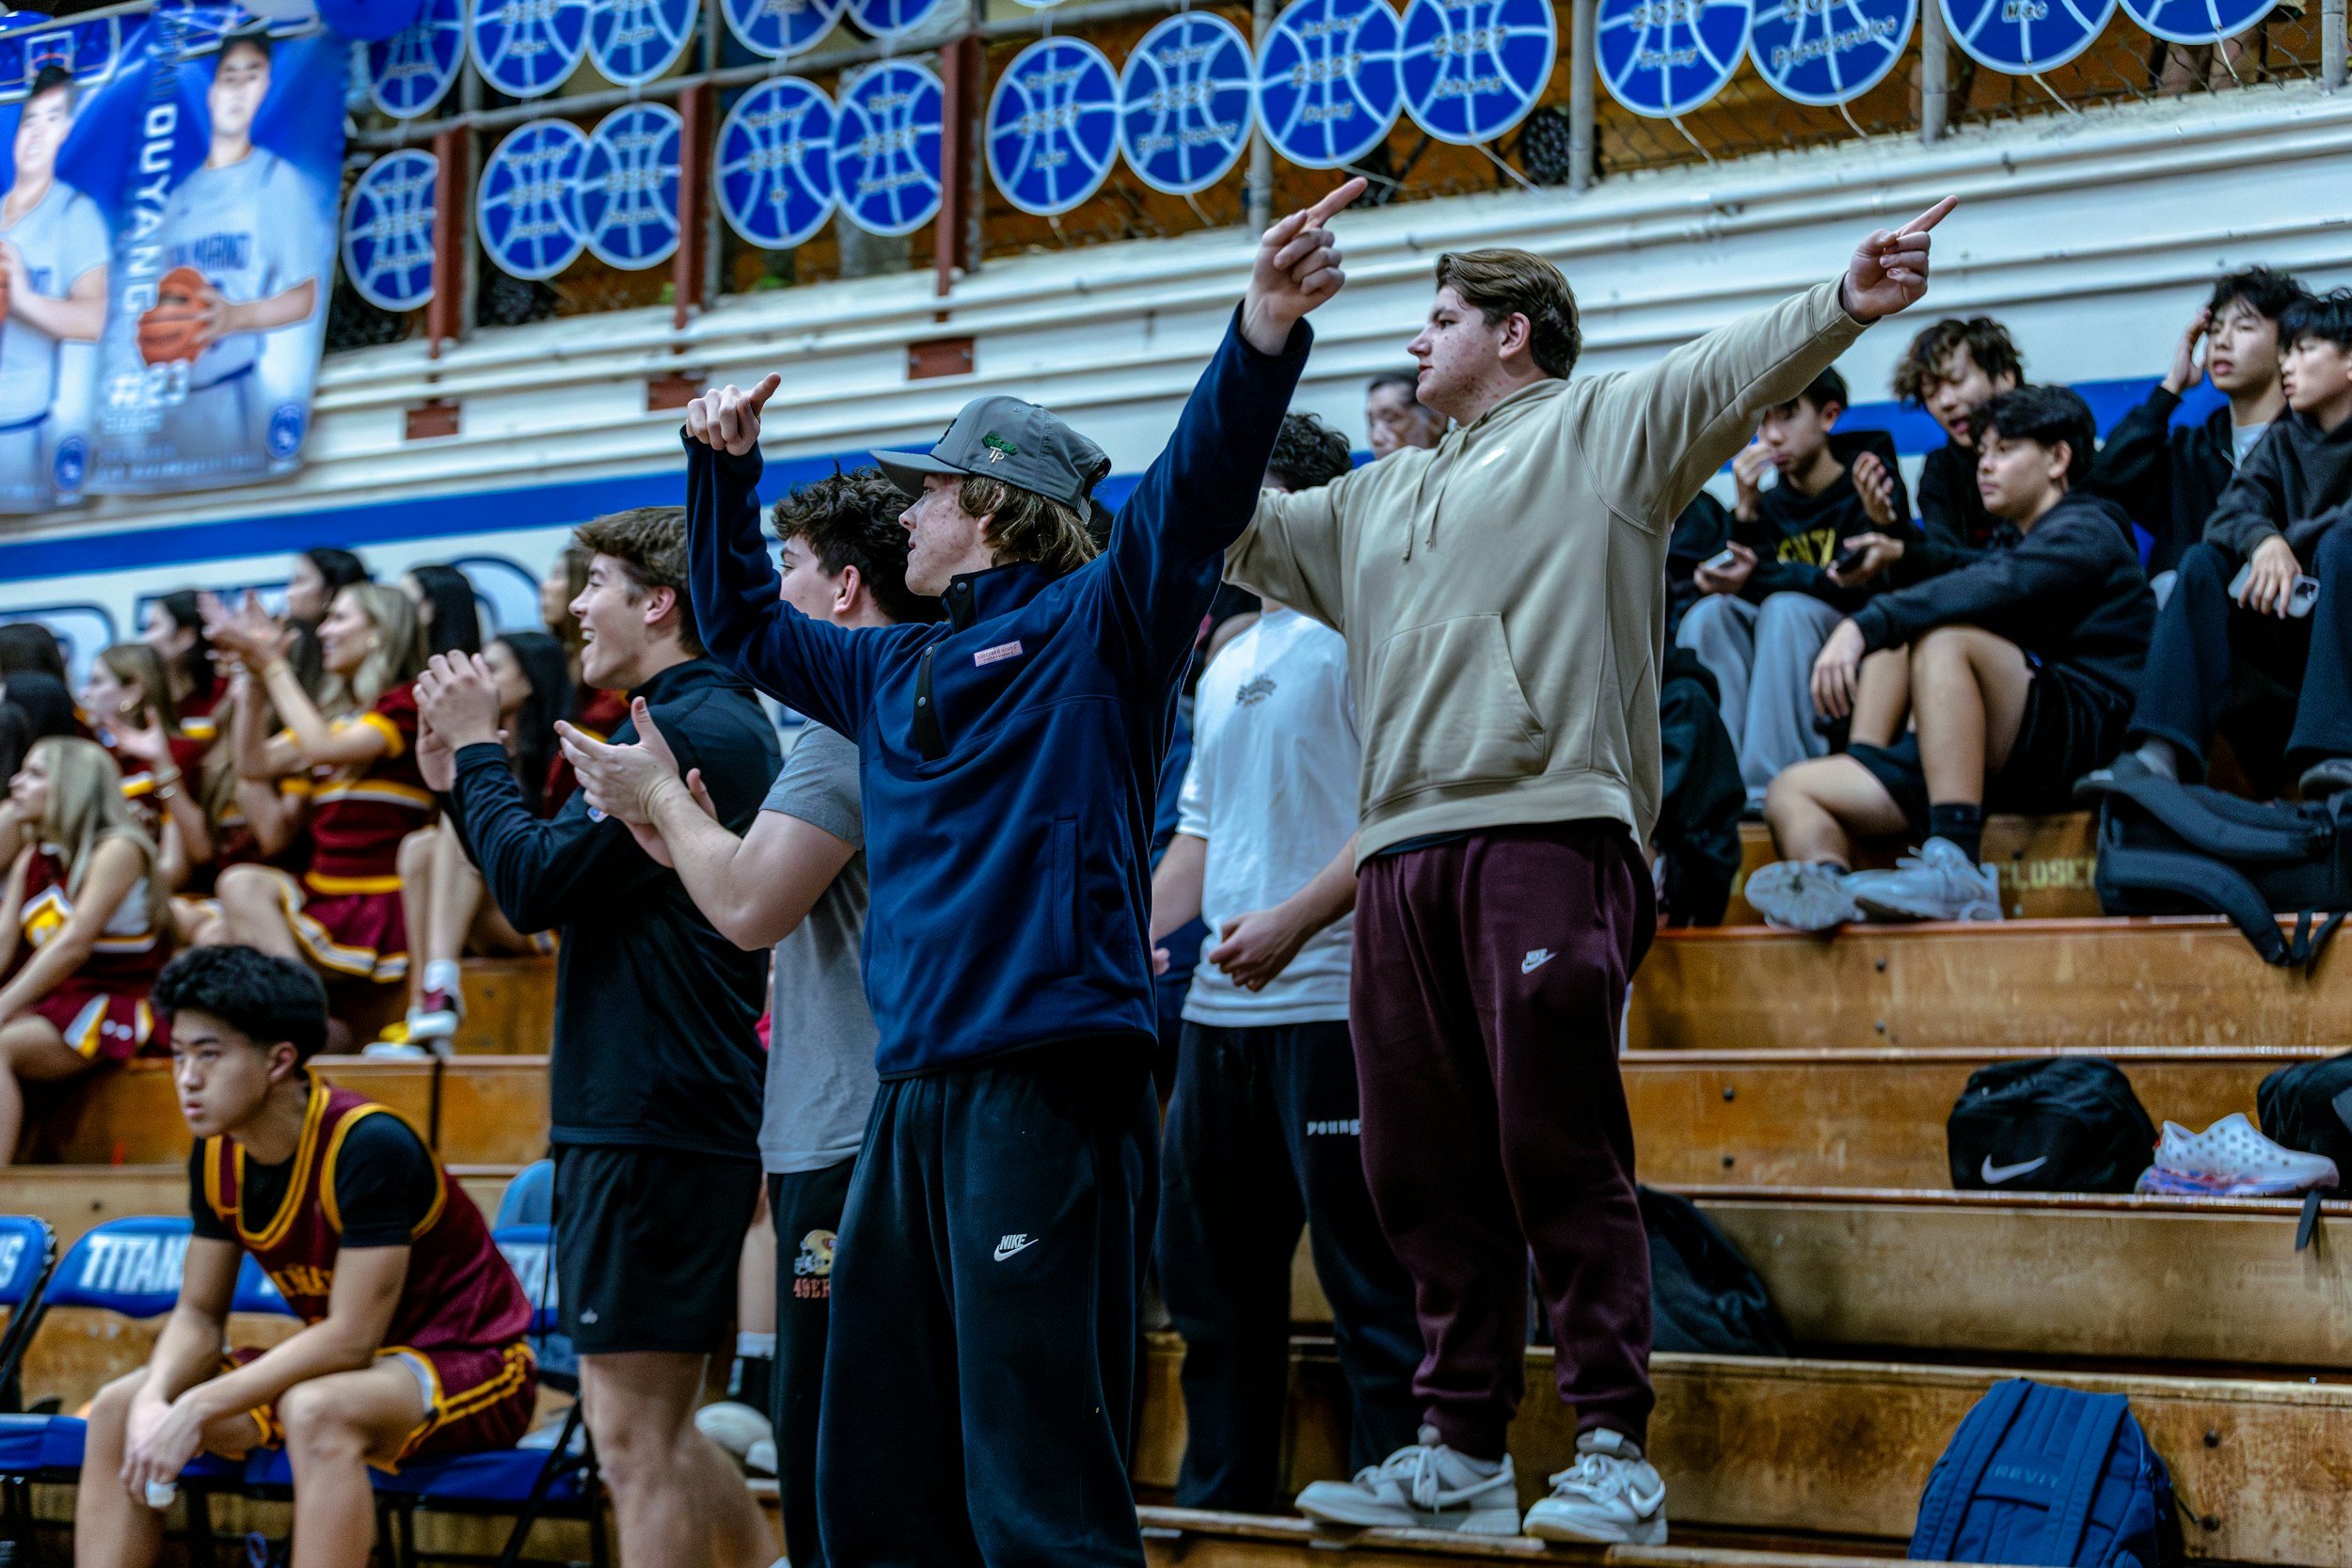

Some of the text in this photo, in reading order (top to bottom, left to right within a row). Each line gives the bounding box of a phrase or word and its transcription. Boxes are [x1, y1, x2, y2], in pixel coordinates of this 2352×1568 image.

[1431, 25, 1509, 59] 2027
[1290, 54, 1362, 88] 2027
[121, 102, 179, 316] OUYANG
[1526, 948, 1548, 964] NIKE
[1000, 1233, 1027, 1250] NIKE
